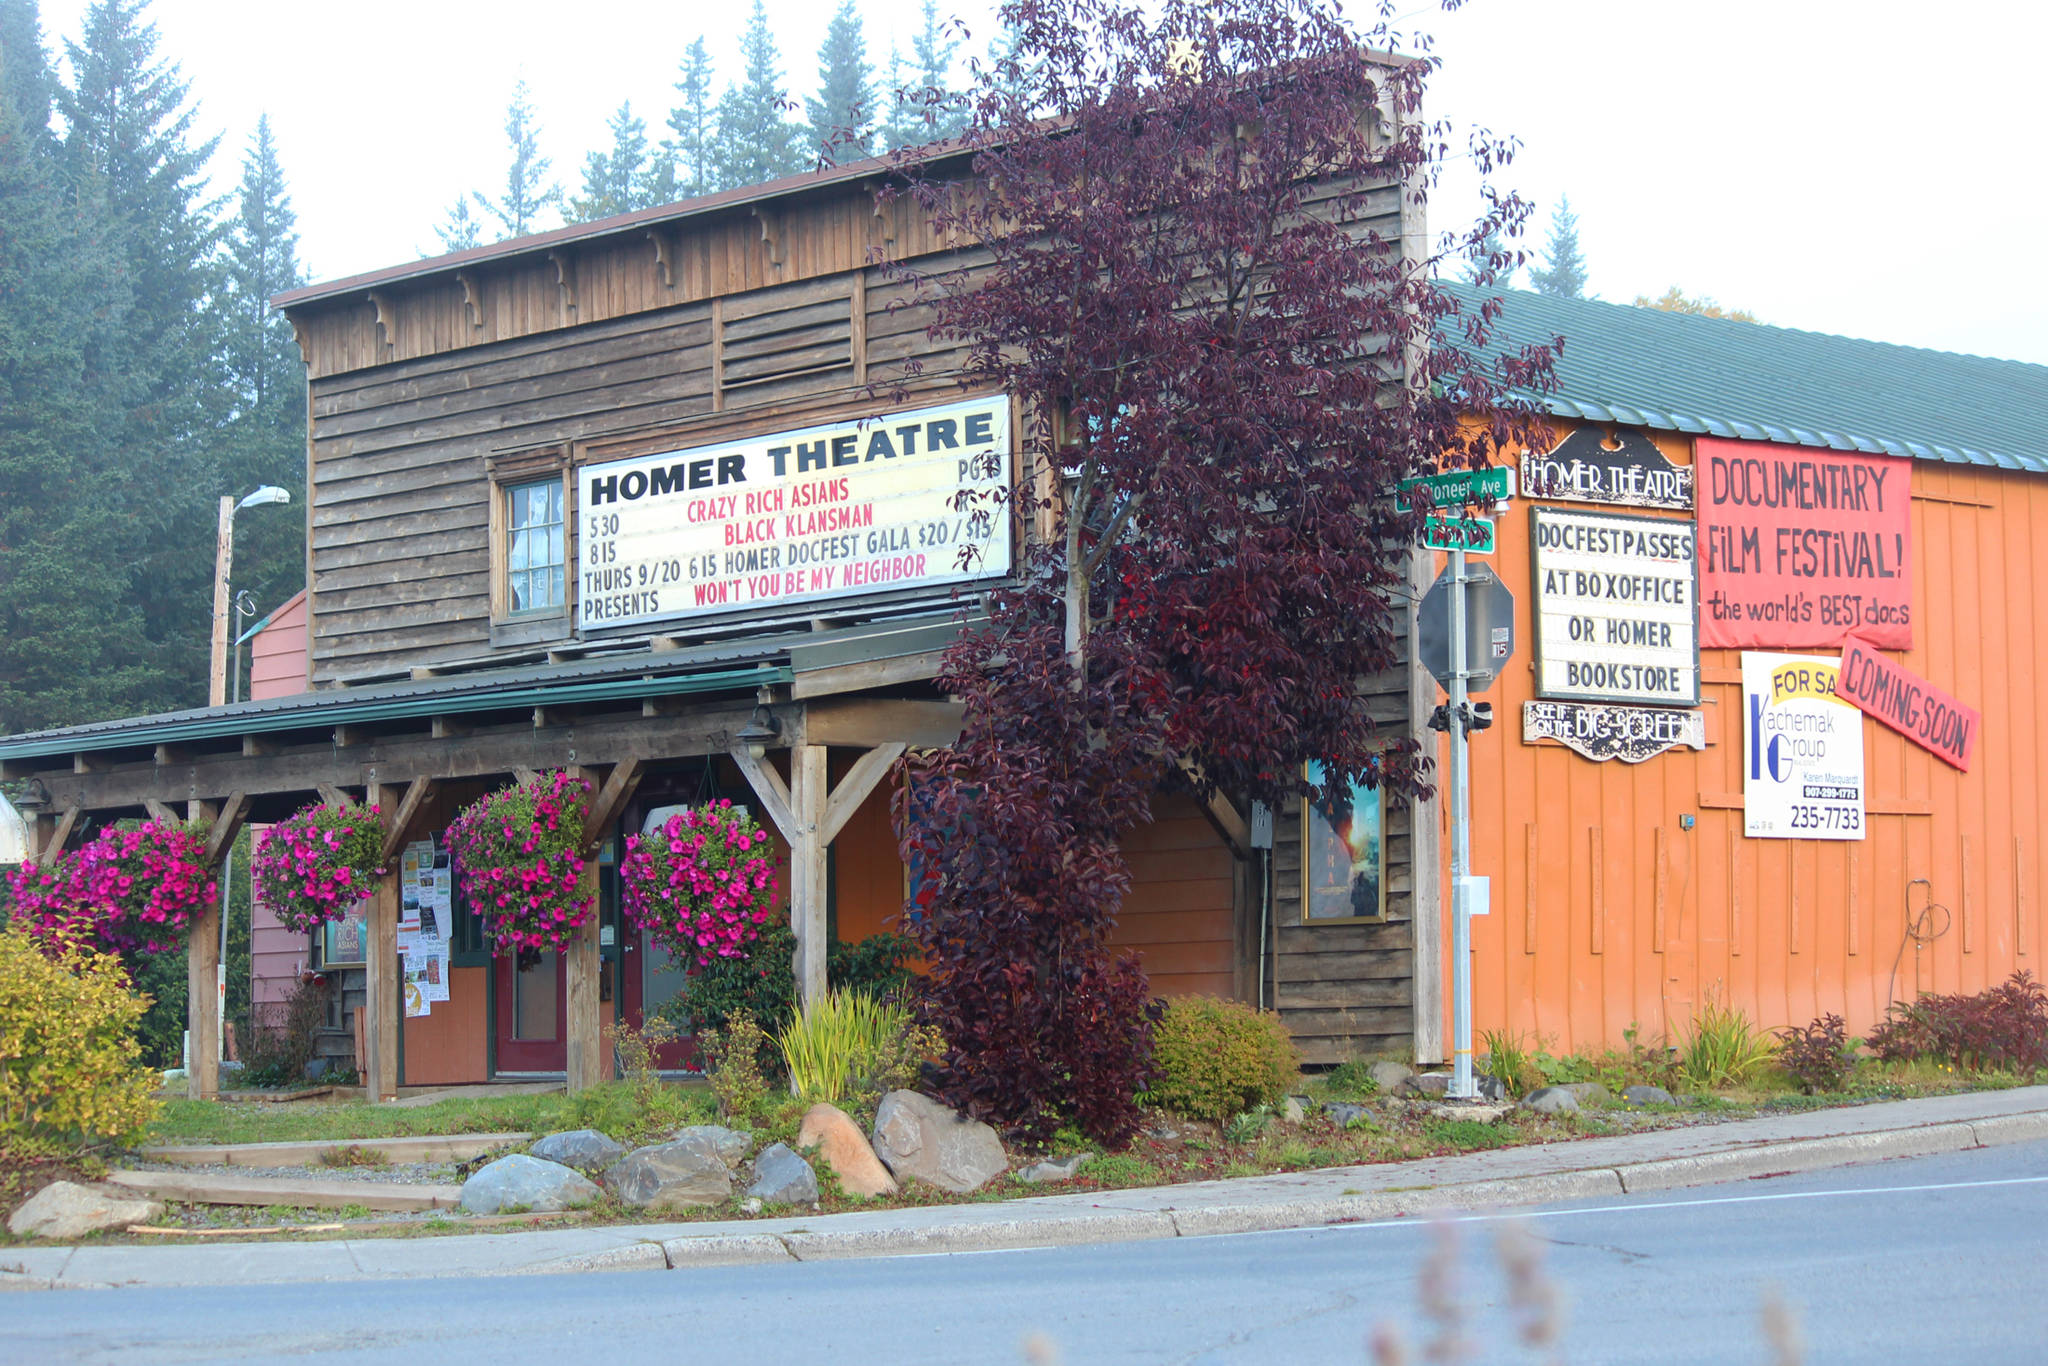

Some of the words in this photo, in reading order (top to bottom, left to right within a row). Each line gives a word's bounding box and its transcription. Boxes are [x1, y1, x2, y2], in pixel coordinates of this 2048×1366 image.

[591, 454, 747, 506] HOMER
[767, 412, 994, 476] THEATRE
[1481, 480, 1501, 493] Ave
[1531, 459, 1605, 493] HOMER
[1607, 465, 1689, 499] THEATRE
[1711, 457, 1890, 512] DOCUMENTARY
[687, 495, 737, 523] CRAZY
[746, 486, 783, 515] RICH
[791, 477, 849, 508] ASIANS
[724, 518, 776, 546] BLACK
[786, 503, 873, 537] KLANSMAN
[585, 566, 632, 593] THURS
[725, 546, 780, 574] HOMER
[788, 533, 860, 566] DOCFEST
[867, 526, 910, 554] GALA
[584, 590, 659, 620] PRESENTS
[694, 579, 741, 606] WON'T
[748, 573, 780, 599] YOU
[785, 570, 804, 595] BE
[810, 565, 836, 592] MY
[844, 553, 926, 586] NEIGHBOR
[1545, 569, 1569, 595] AT
[1707, 590, 1742, 620] the
[1747, 592, 1813, 623] world's
[1820, 594, 1862, 627] BEST
[1865, 598, 1910, 625] docs
[1568, 615, 1595, 642] OR
[1606, 618, 1672, 648] HOMER
[1567, 661, 1681, 692] BOOKSTORE
[1773, 669, 1810, 697] FOR
[1536, 703, 1556, 719] SEE
[1557, 705, 1567, 720] IT
[1845, 648, 1921, 729] COMING
[1919, 696, 1970, 759] SOON
[1536, 719, 1554, 733] ON
[1554, 720, 1573, 736] THE
[1576, 710, 1611, 738] BIG
[1615, 711, 1695, 741] SCREEN
[1767, 733, 1826, 783] Group
[1803, 771, 1824, 783] Karen
[1825, 773, 1858, 786] Marquardt
[1791, 805, 1860, 830] 235-7733
